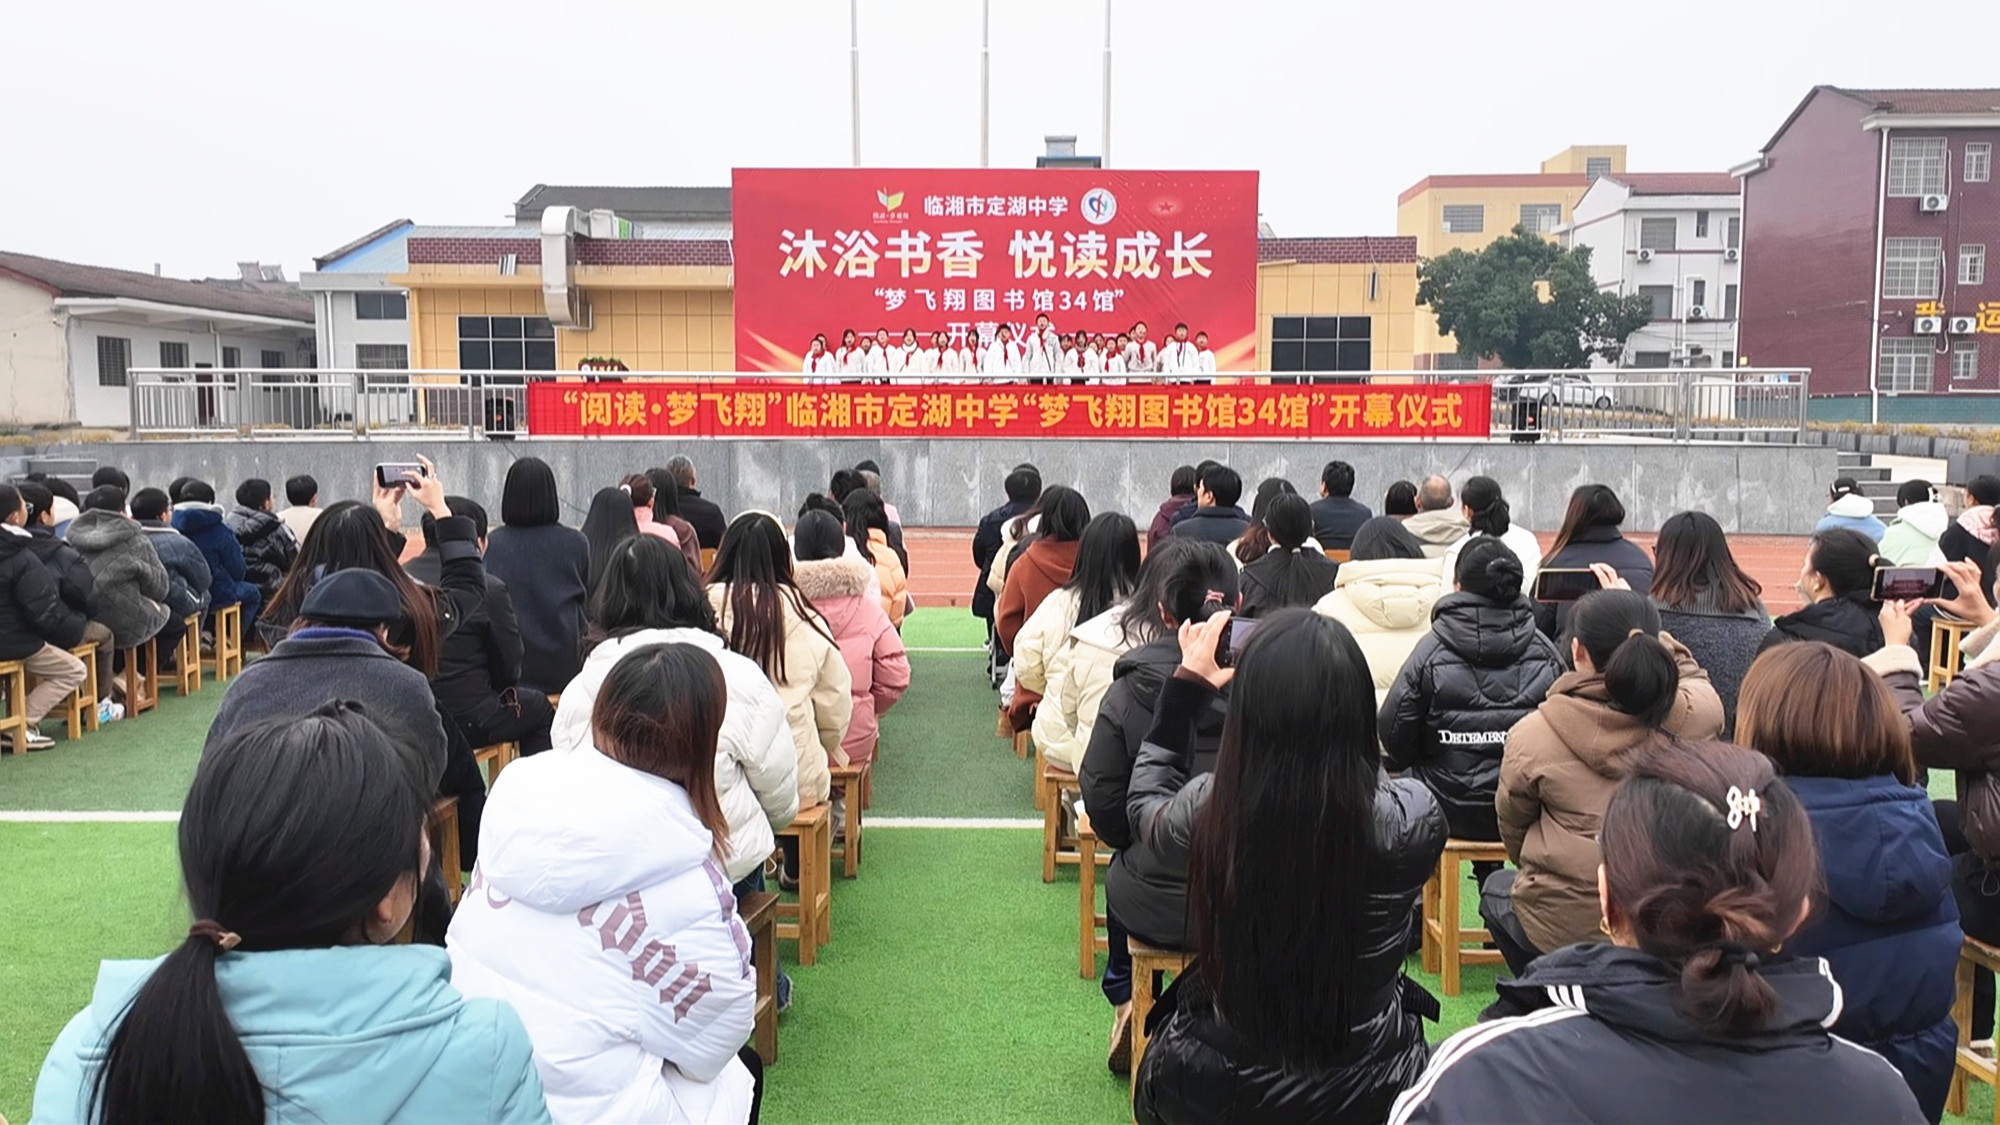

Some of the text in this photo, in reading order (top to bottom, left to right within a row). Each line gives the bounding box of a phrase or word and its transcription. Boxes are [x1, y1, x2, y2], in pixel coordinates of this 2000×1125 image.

[925, 196, 1068, 217] 临湘市定湖中学
[779, 229, 1212, 279] 沐浴书香 悦读成长
